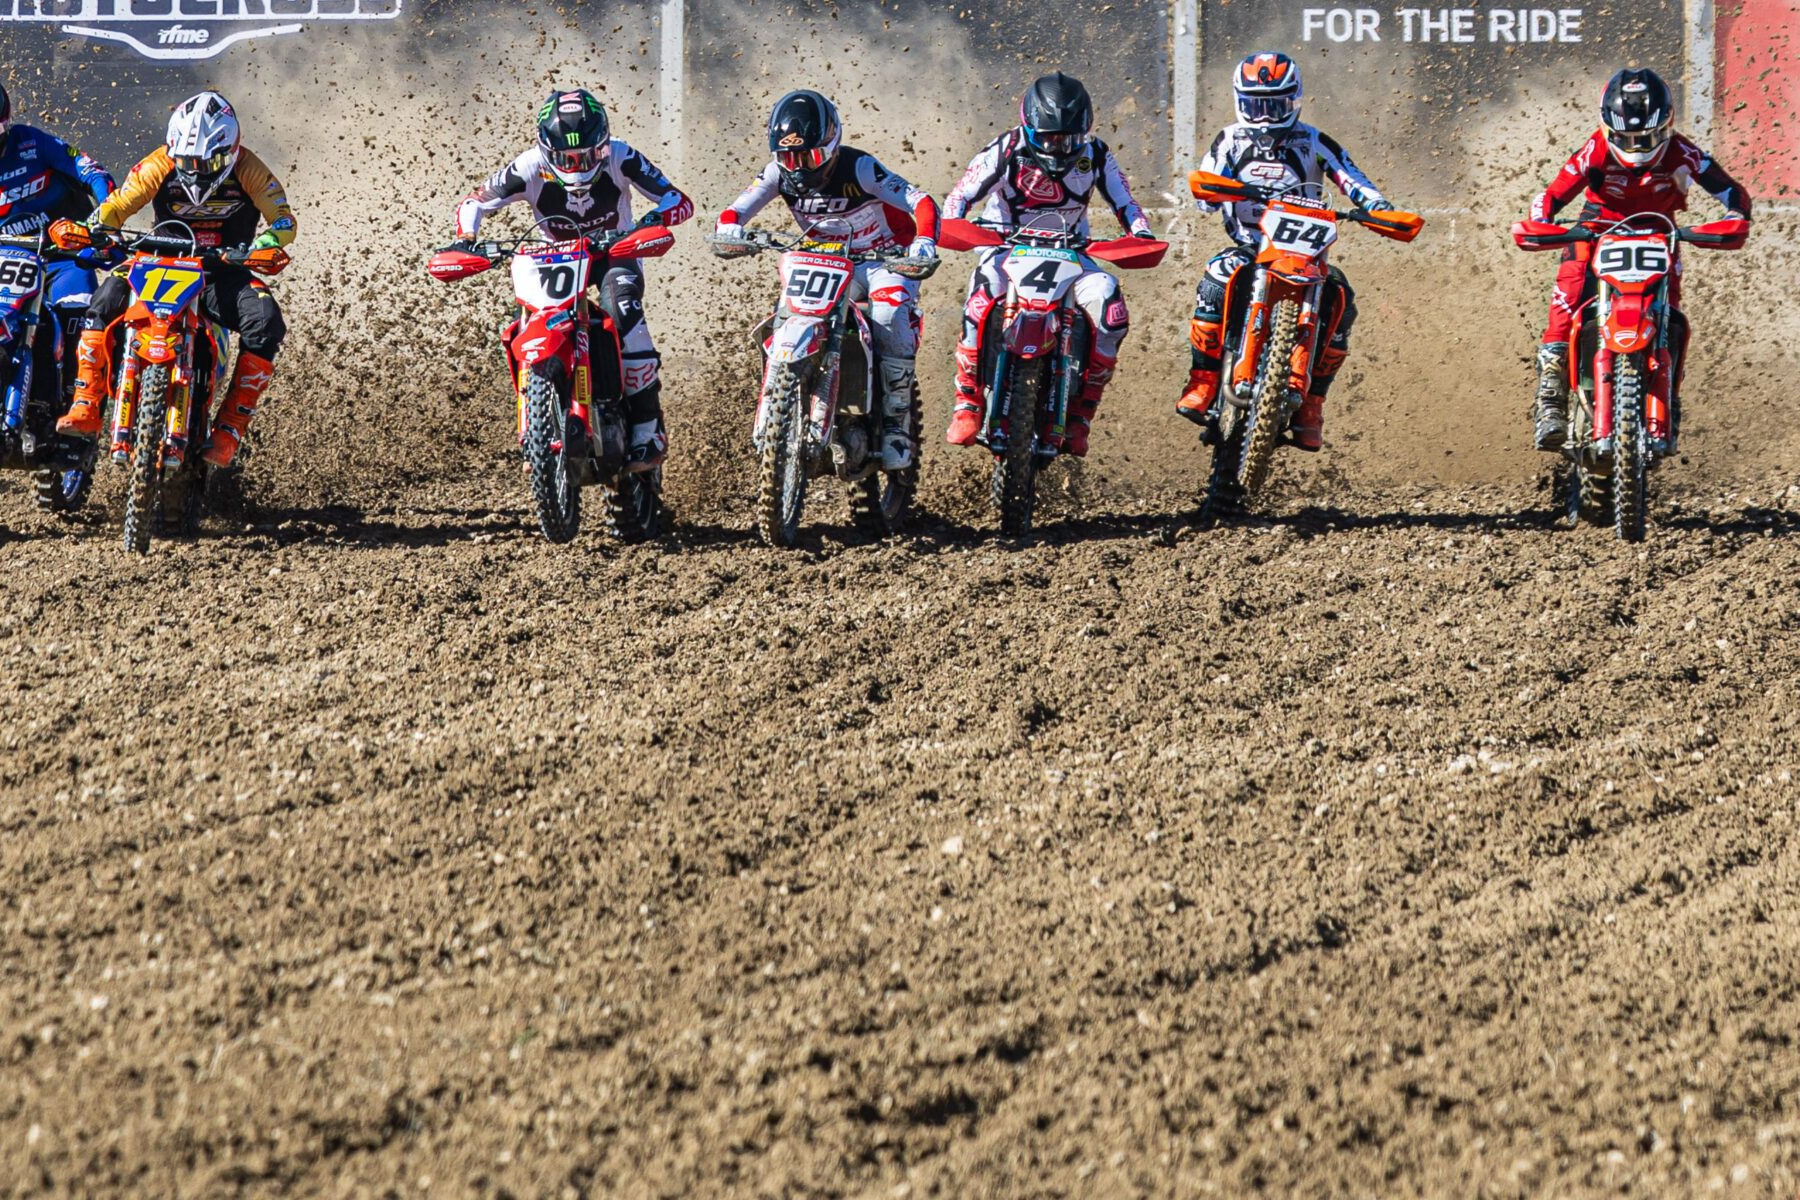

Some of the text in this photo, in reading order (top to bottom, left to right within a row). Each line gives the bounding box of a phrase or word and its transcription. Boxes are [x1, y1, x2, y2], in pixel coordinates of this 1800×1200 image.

[158, 24, 210, 44] rfme
[1303, 8, 1583, 43] FOR THE RIDE
[794, 197, 849, 214] UFO
[1, 211, 50, 237] YAMAHA
[549, 211, 615, 231] HONDA
[1271, 216, 1331, 252] 64
[1026, 248, 1072, 260] MOTOREX
[1599, 246, 1667, 275] 96
[139, 267, 201, 304] 17
[785, 268, 843, 302] 501
[1019, 260, 1061, 294] 4
